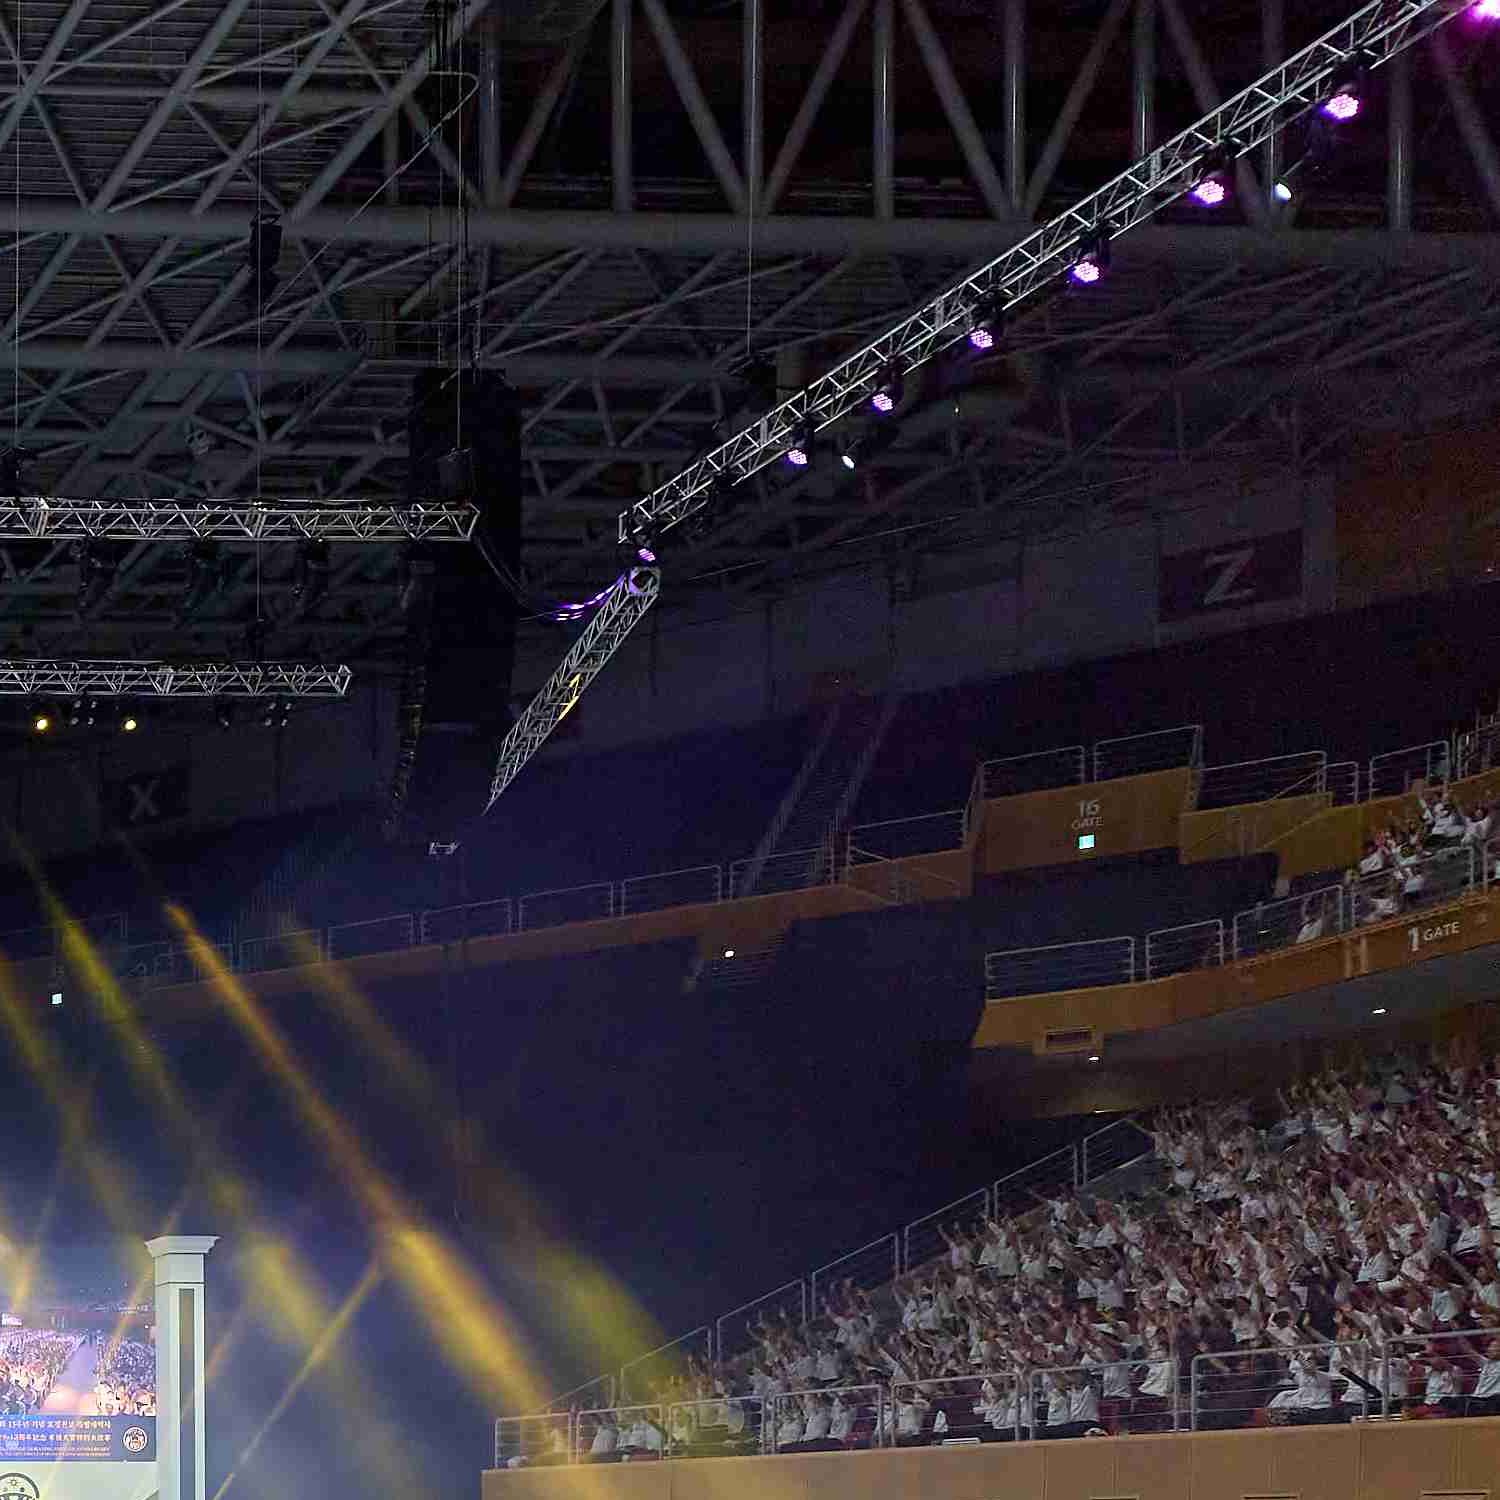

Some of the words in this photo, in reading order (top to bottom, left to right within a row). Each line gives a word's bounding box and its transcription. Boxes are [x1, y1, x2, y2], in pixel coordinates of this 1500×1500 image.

[1204, 545, 1257, 605] Z
[1071, 815, 1105, 831] GATE
[1408, 926, 1420, 952] 1
[1423, 920, 1461, 941] GATE
